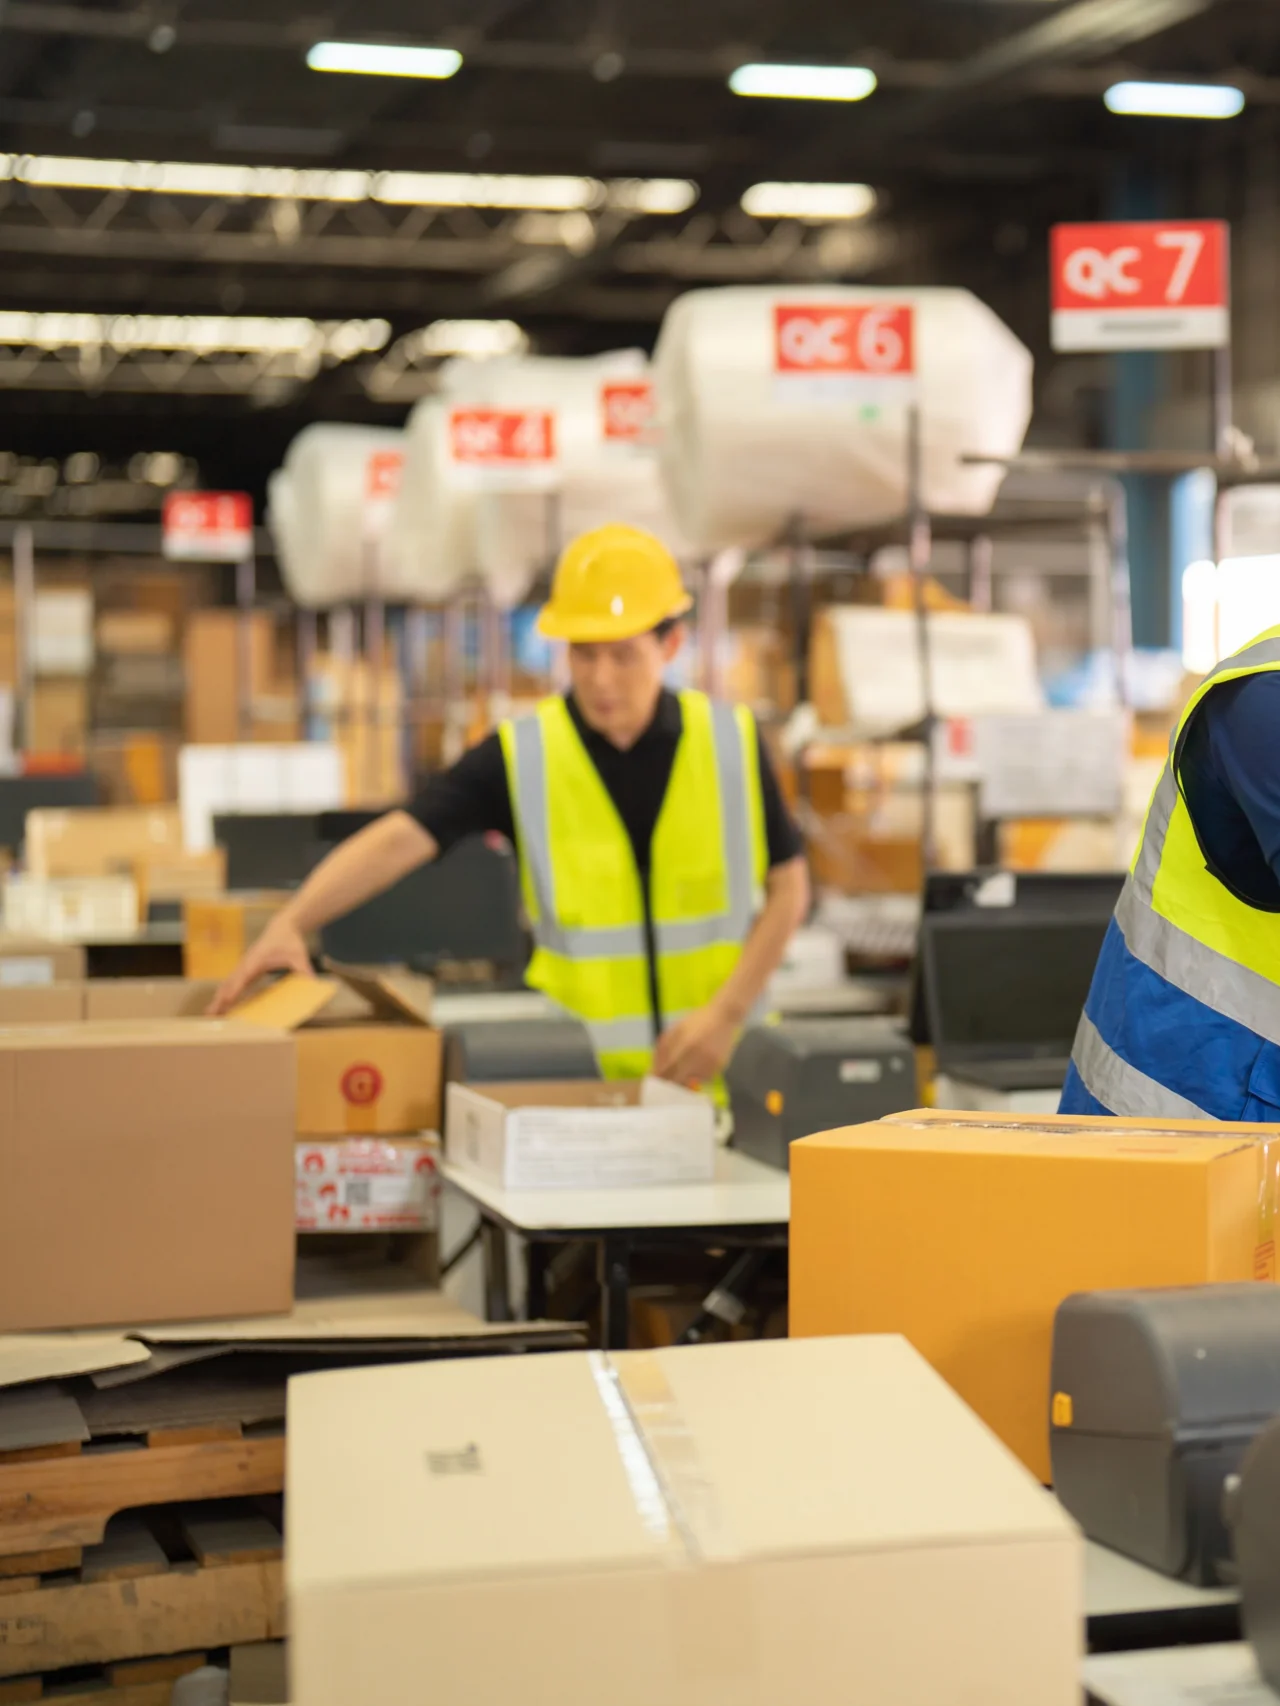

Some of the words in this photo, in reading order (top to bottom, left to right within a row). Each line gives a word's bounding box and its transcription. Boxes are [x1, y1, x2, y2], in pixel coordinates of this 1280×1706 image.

[1062, 245, 1142, 299] QC
[1154, 230, 1205, 304] 7
[779, 316, 849, 365] QC
[858, 304, 904, 373] 6
